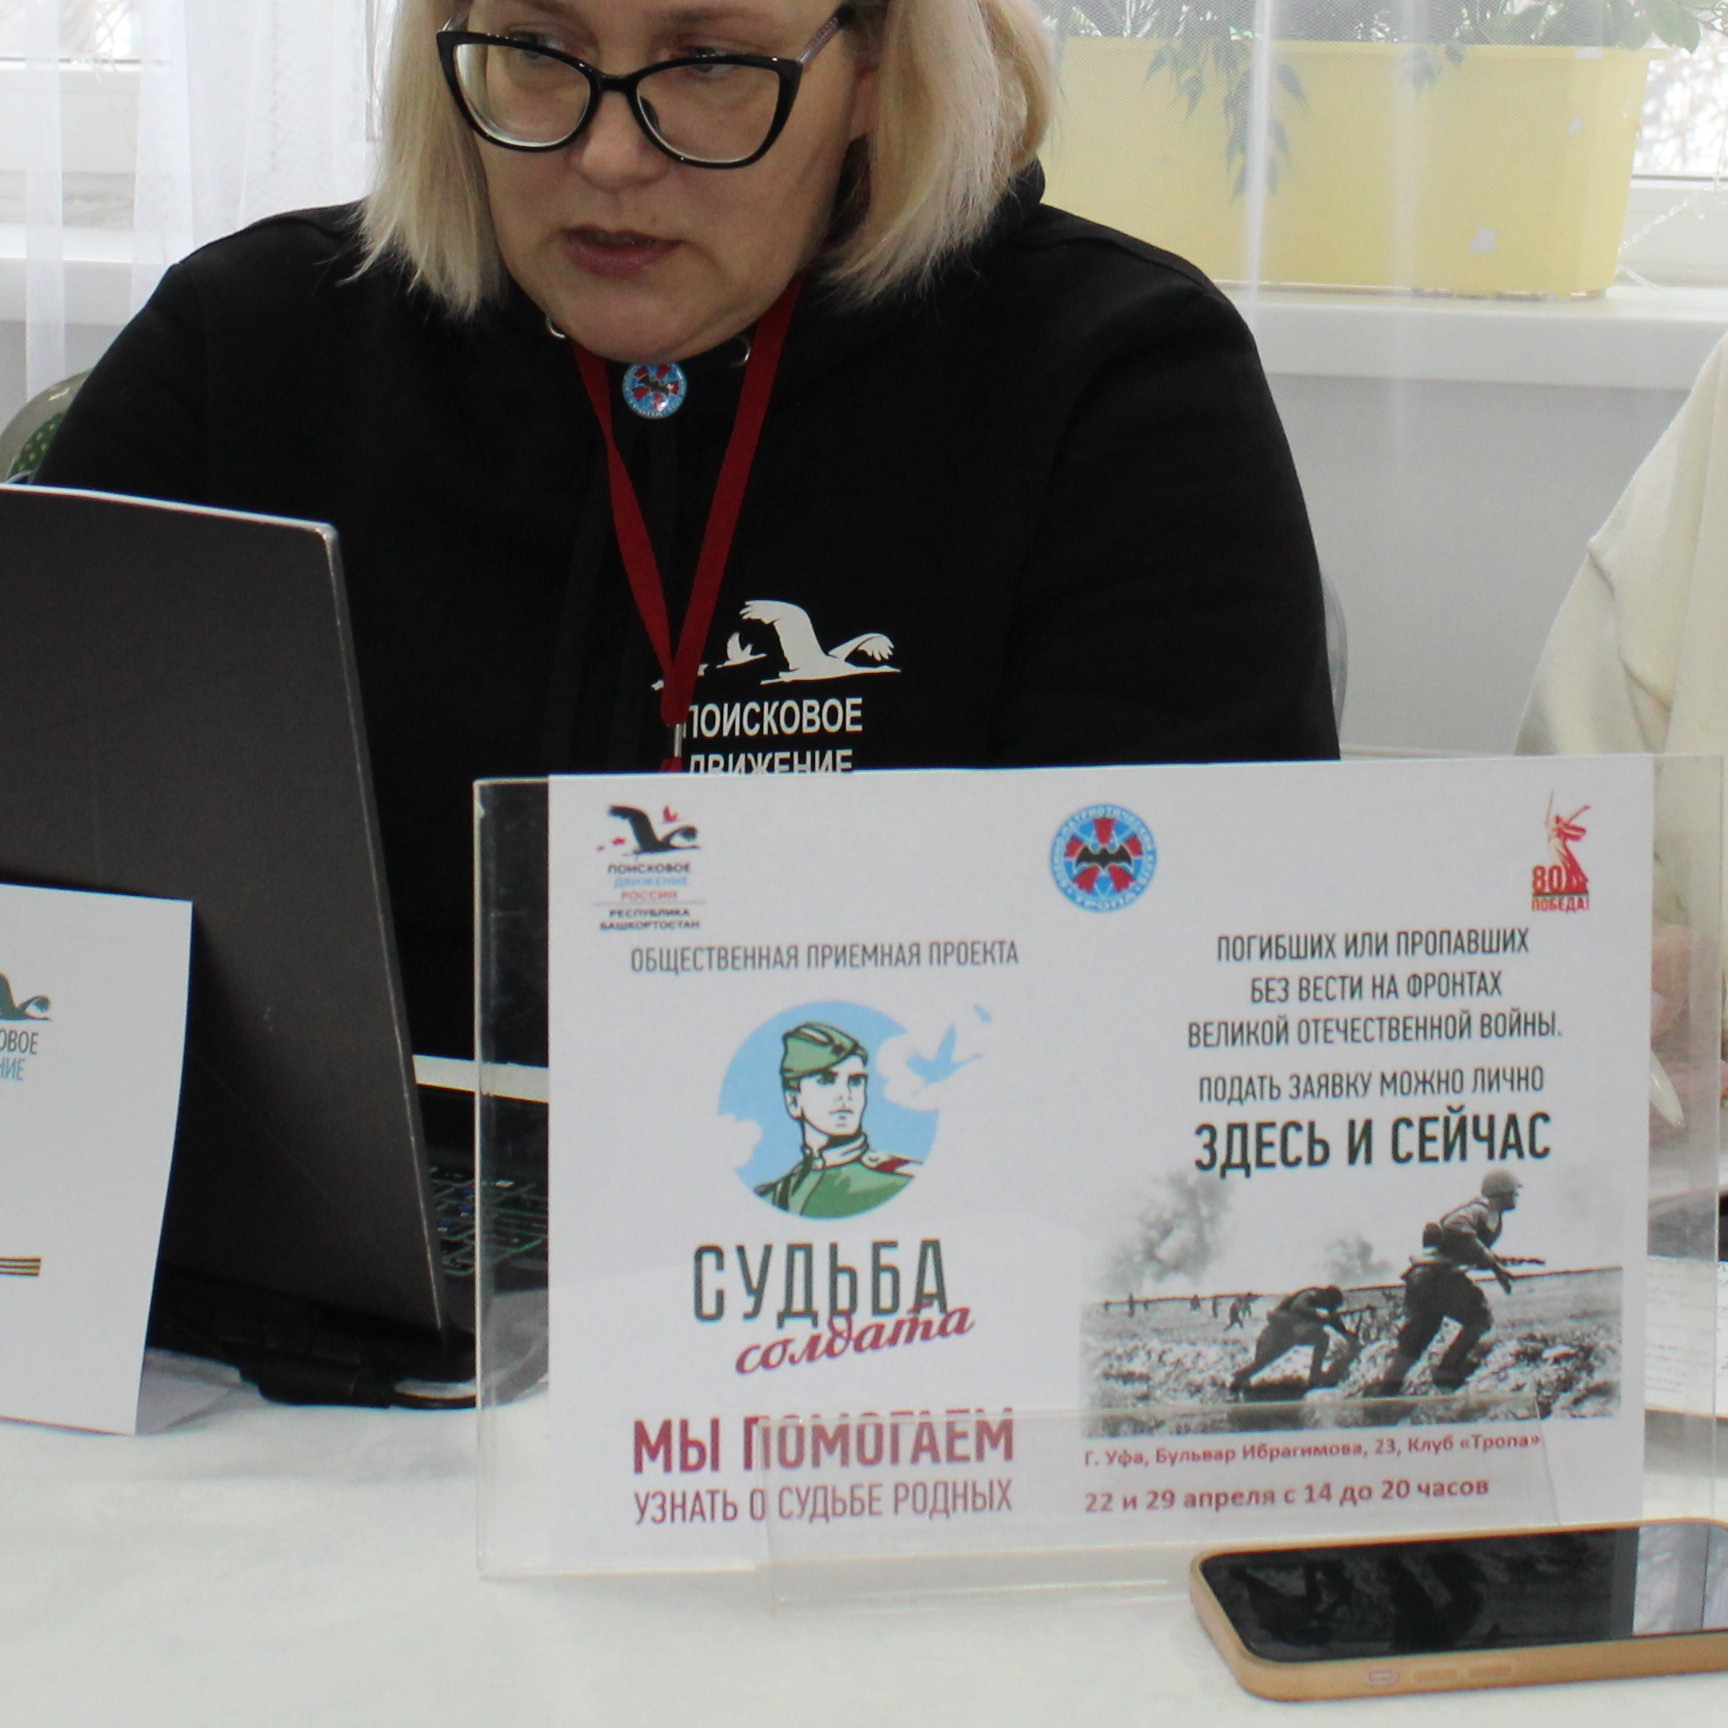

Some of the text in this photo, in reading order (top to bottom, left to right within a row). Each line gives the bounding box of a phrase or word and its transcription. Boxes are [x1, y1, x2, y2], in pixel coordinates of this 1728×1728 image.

[684, 697, 863, 739] ПОИСКОВОЕ
[608, 863, 691, 874] ПОИСКОВОЕ
[614, 877, 688, 888] ДВИЖЕНИЕ
[1532, 865, 1563, 893] 80
[609, 908, 690, 918] РЕСПУБЛИКА
[621, 890, 678, 901] РОССИИ
[1532, 896, 1589, 912] ПОБЕДА!
[600, 920, 700, 930] БАШКОРТОСТАН
[631, 940, 1019, 975] ОБЩЕСТВЕННАЯ ПРИЕМНАЯ ПРОЕКТА
[1217, 927, 1530, 962] ПОГИБШИХ ИЛИ ПРОПАВШИХ
[1250, 970, 1502, 1002] БЕЗ ВЕСТИ НА ФРОНТАХ
[1188, 1005, 1562, 1049] ВЕЛИКОЙ ОТЕЧЕСТВЕННОЙ ВОЙНЫ.
[1198, 1065, 1545, 1106] ПОДАТЬ ЗАЯВКУ МОЖНО ЛИЧНО
[1194, 1103, 1552, 1178] ЗДЕСЬ И СЕЙЧАС
[692, 1238, 949, 1329] СУДЬБА
[735, 1302, 976, 1375] солдата
[633, 1408, 1014, 1474] МЫ ПОМОГАЕМ
[1084, 1432, 1542, 1469] Г. Уфа, Бульвар Ибрагимова, 23, Клуб «Тропа»
[634, 1478, 1014, 1525] УЗНАТЬ О СУДЬБЕ РОДНЫХ
[1084, 1477, 1490, 1513] 22 и 29 апреля с 14 до 20 часов
